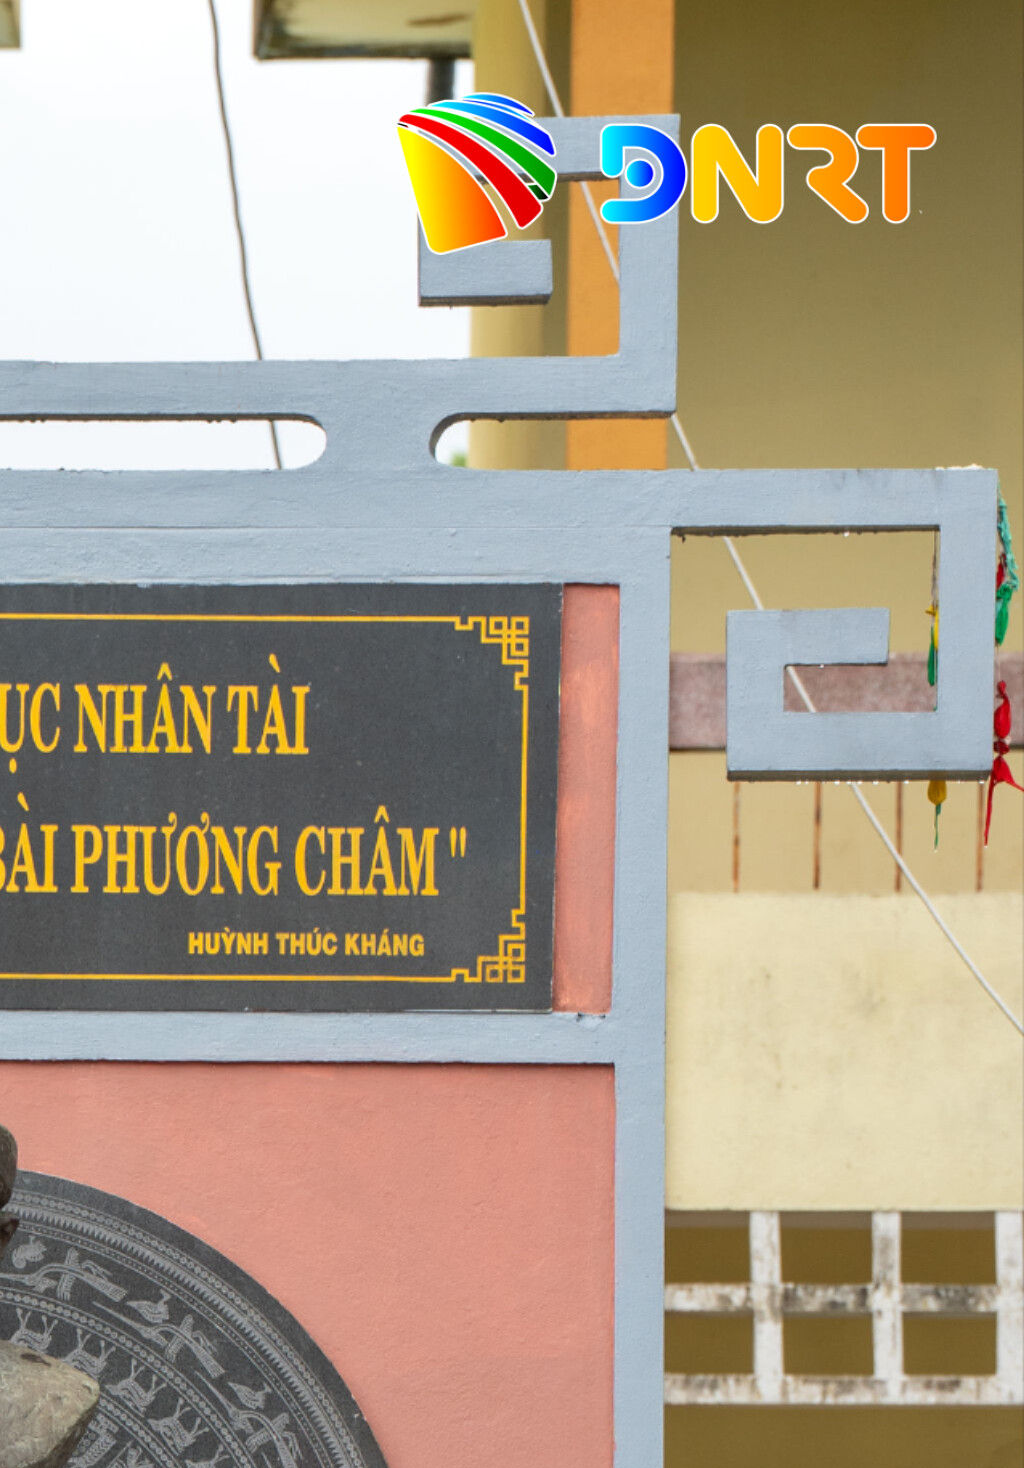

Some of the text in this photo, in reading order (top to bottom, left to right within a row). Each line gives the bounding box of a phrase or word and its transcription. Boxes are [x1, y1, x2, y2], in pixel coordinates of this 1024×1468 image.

[74, 663, 218, 755] NHÂN
[227, 654, 311, 756] TÀI
[71, 813, 283, 897] PHƯƠNG
[188, 928, 426, 958] HUỲNH THÚC KHÁNG
